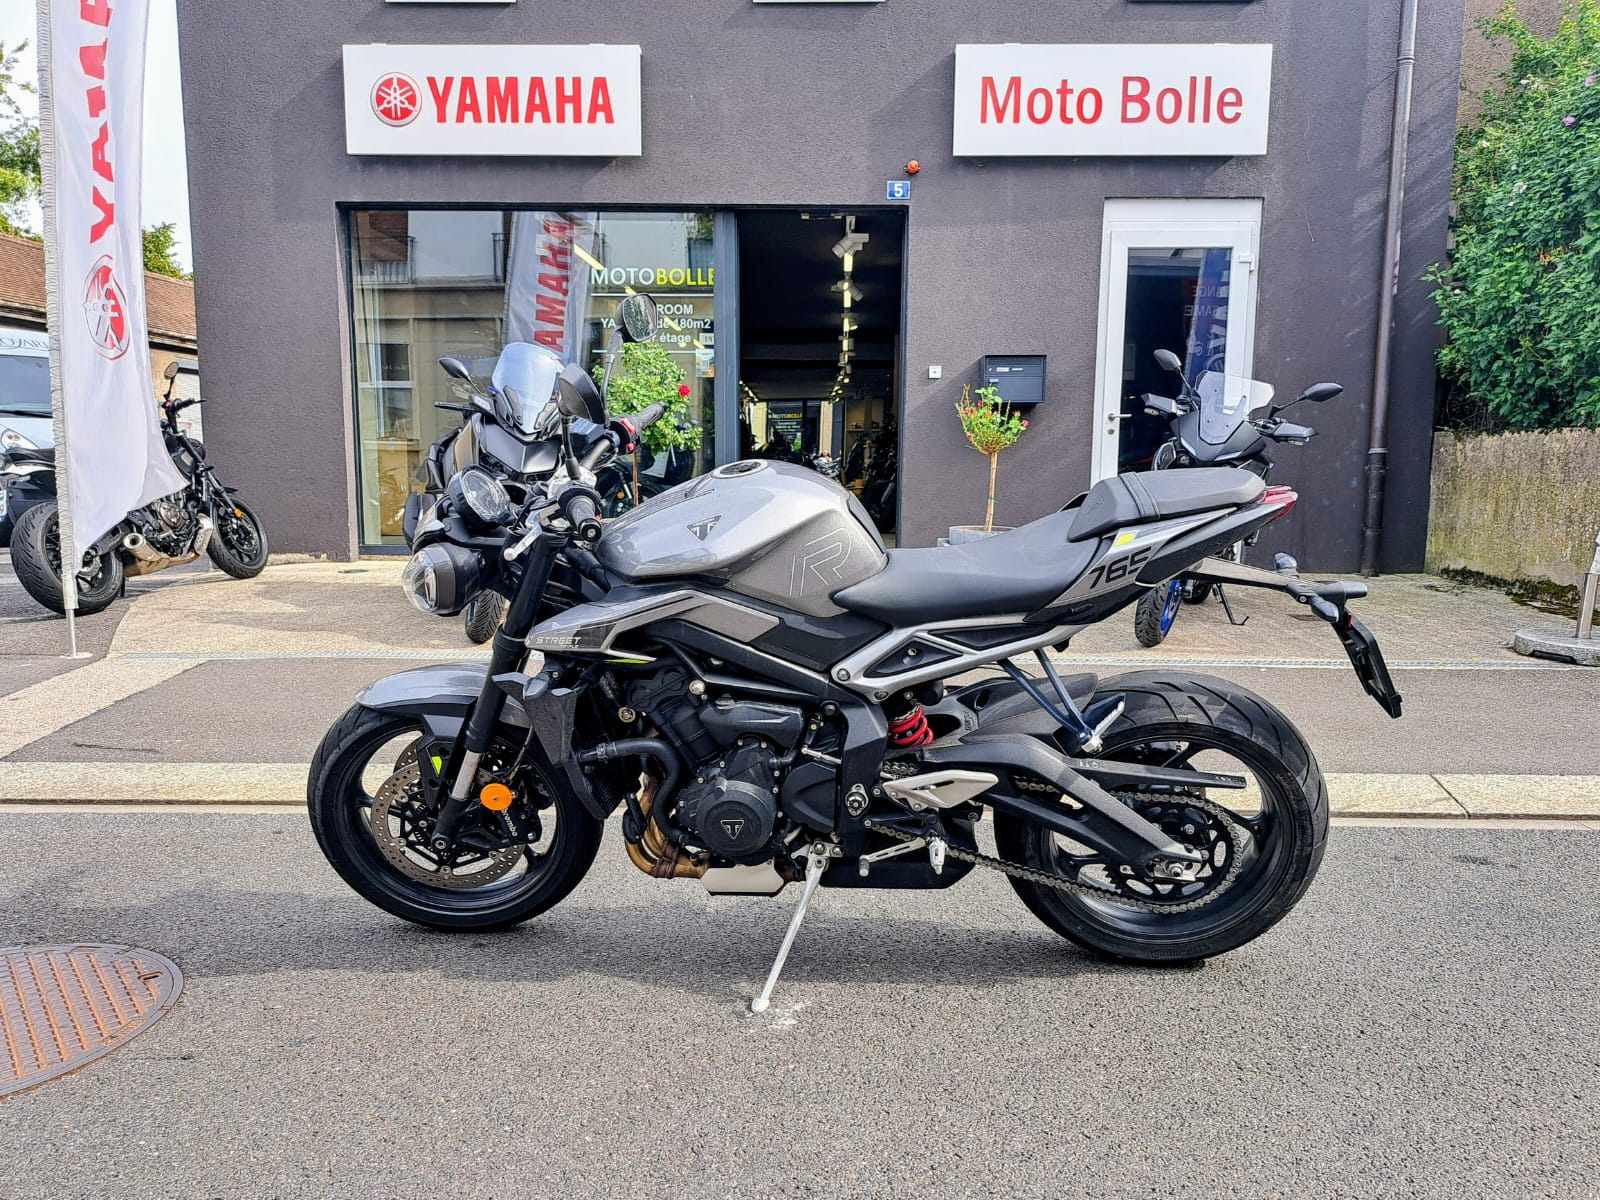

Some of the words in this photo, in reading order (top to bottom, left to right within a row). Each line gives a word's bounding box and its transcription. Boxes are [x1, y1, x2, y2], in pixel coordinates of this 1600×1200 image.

[426, 76, 615, 124] YAMAHA
[979, 76, 1103, 125] Moto
[1120, 76, 1244, 125] Bolle
[893, 184, 904, 197] 5
[534, 219, 575, 353] AMAHA
[591, 267, 714, 286] MOTOBOLLE
[657, 304, 693, 315] ROOM
[660, 332, 691, 347] étage
[789, 527, 852, 598] R
[1088, 546, 1152, 590] 765
[536, 636, 582, 645] STREET
